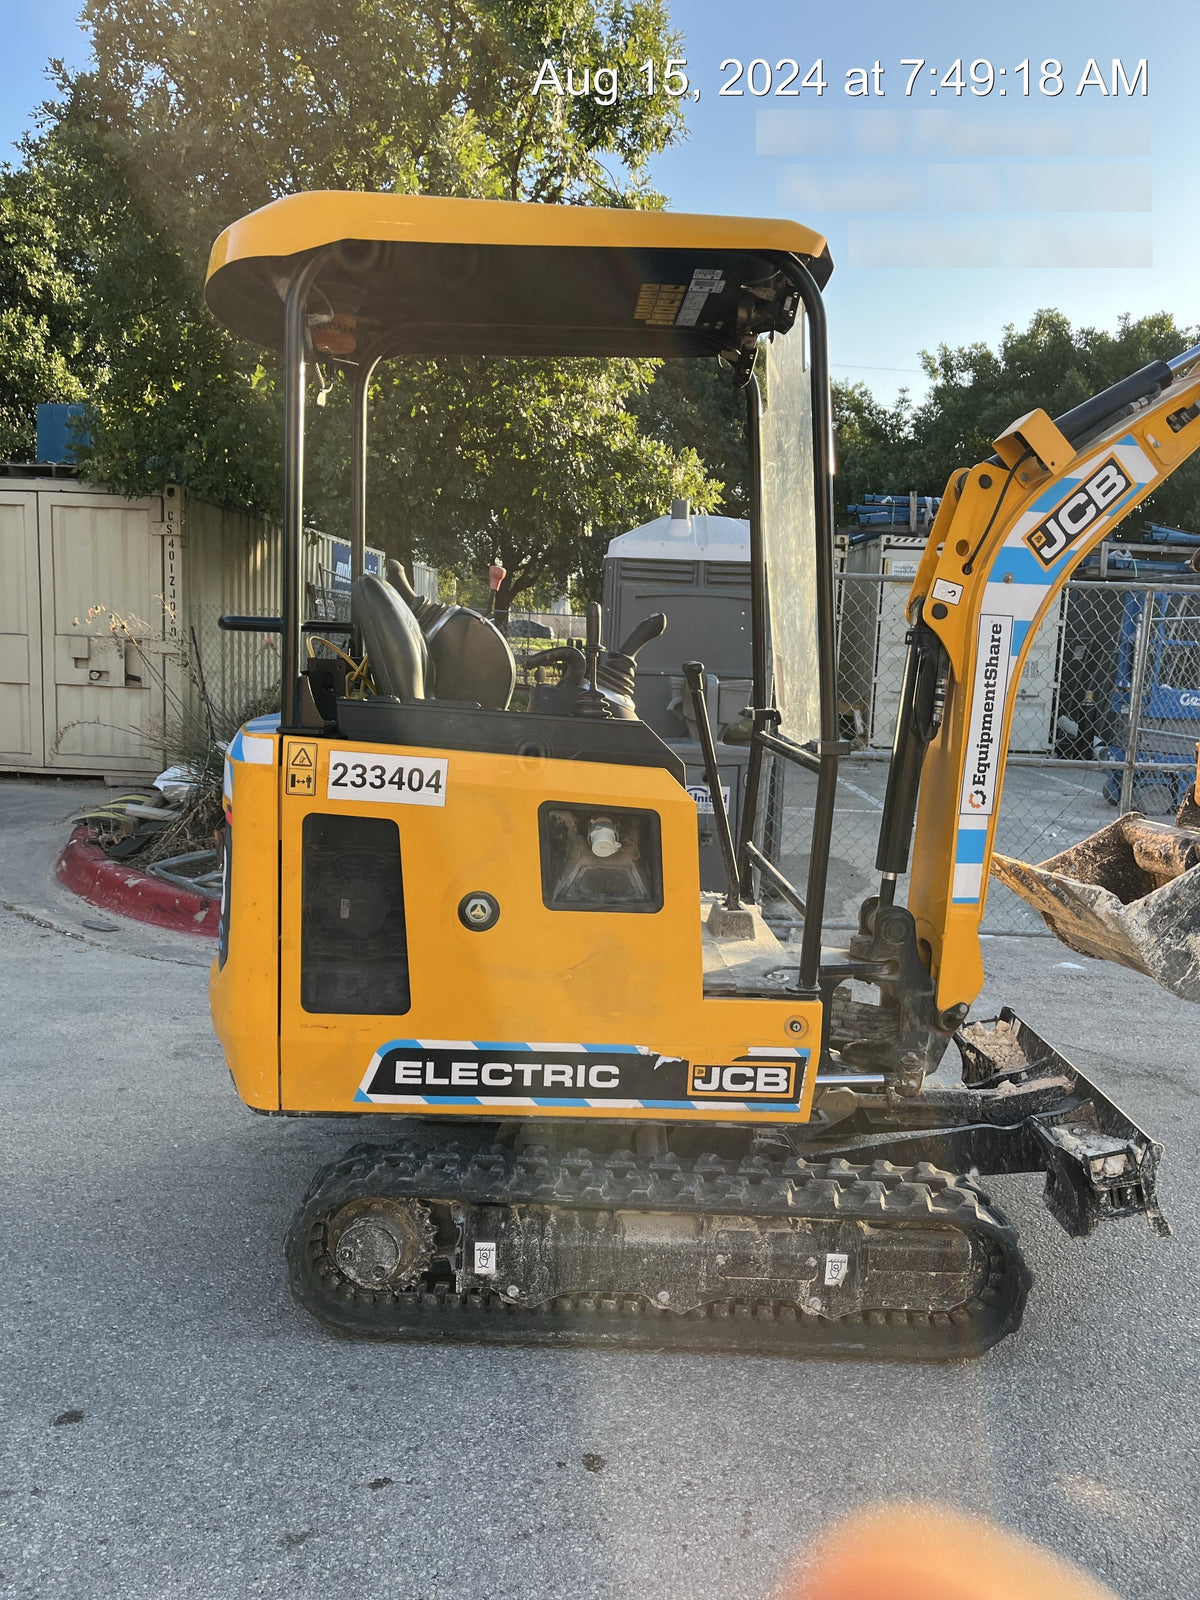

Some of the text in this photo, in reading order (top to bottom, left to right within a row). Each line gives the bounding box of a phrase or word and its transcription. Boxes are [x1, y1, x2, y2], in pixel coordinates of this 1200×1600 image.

[1040, 465, 1126, 559] JCB
[972, 622, 1003, 787] EquipmentShare
[331, 762, 442, 794] 233404
[394, 1060, 620, 1089] ELECTRIC
[694, 1066, 788, 1092] JCB
